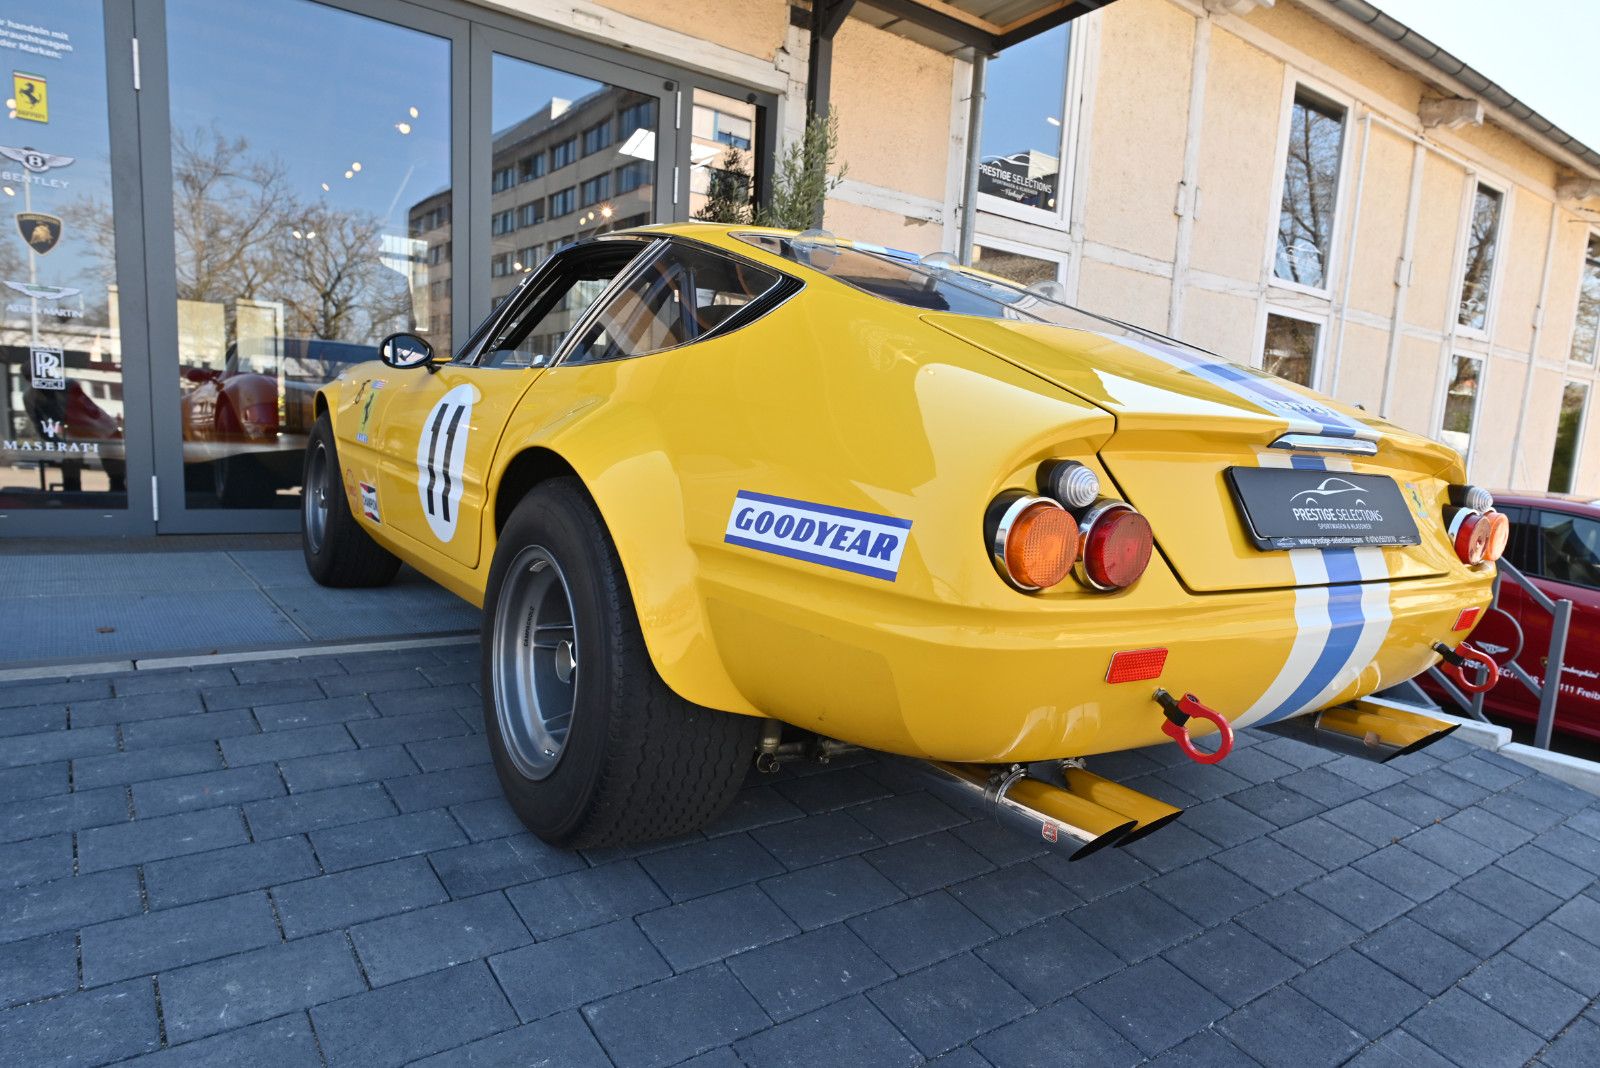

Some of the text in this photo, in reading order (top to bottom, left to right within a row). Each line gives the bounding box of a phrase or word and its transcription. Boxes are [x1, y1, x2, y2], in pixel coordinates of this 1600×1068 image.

[2, 171, 70, 189] BENTLEY
[978, 163, 1052, 194] PRESTIGE SELECTIONS
[3, 440, 99, 453] MASERATI
[427, 403, 466, 523] 11
[1292, 507, 1383, 522] PRESTIGE SELECTIONS
[735, 506, 899, 562] GOODYEAR
[1560, 662, 1600, 679] amborghini
